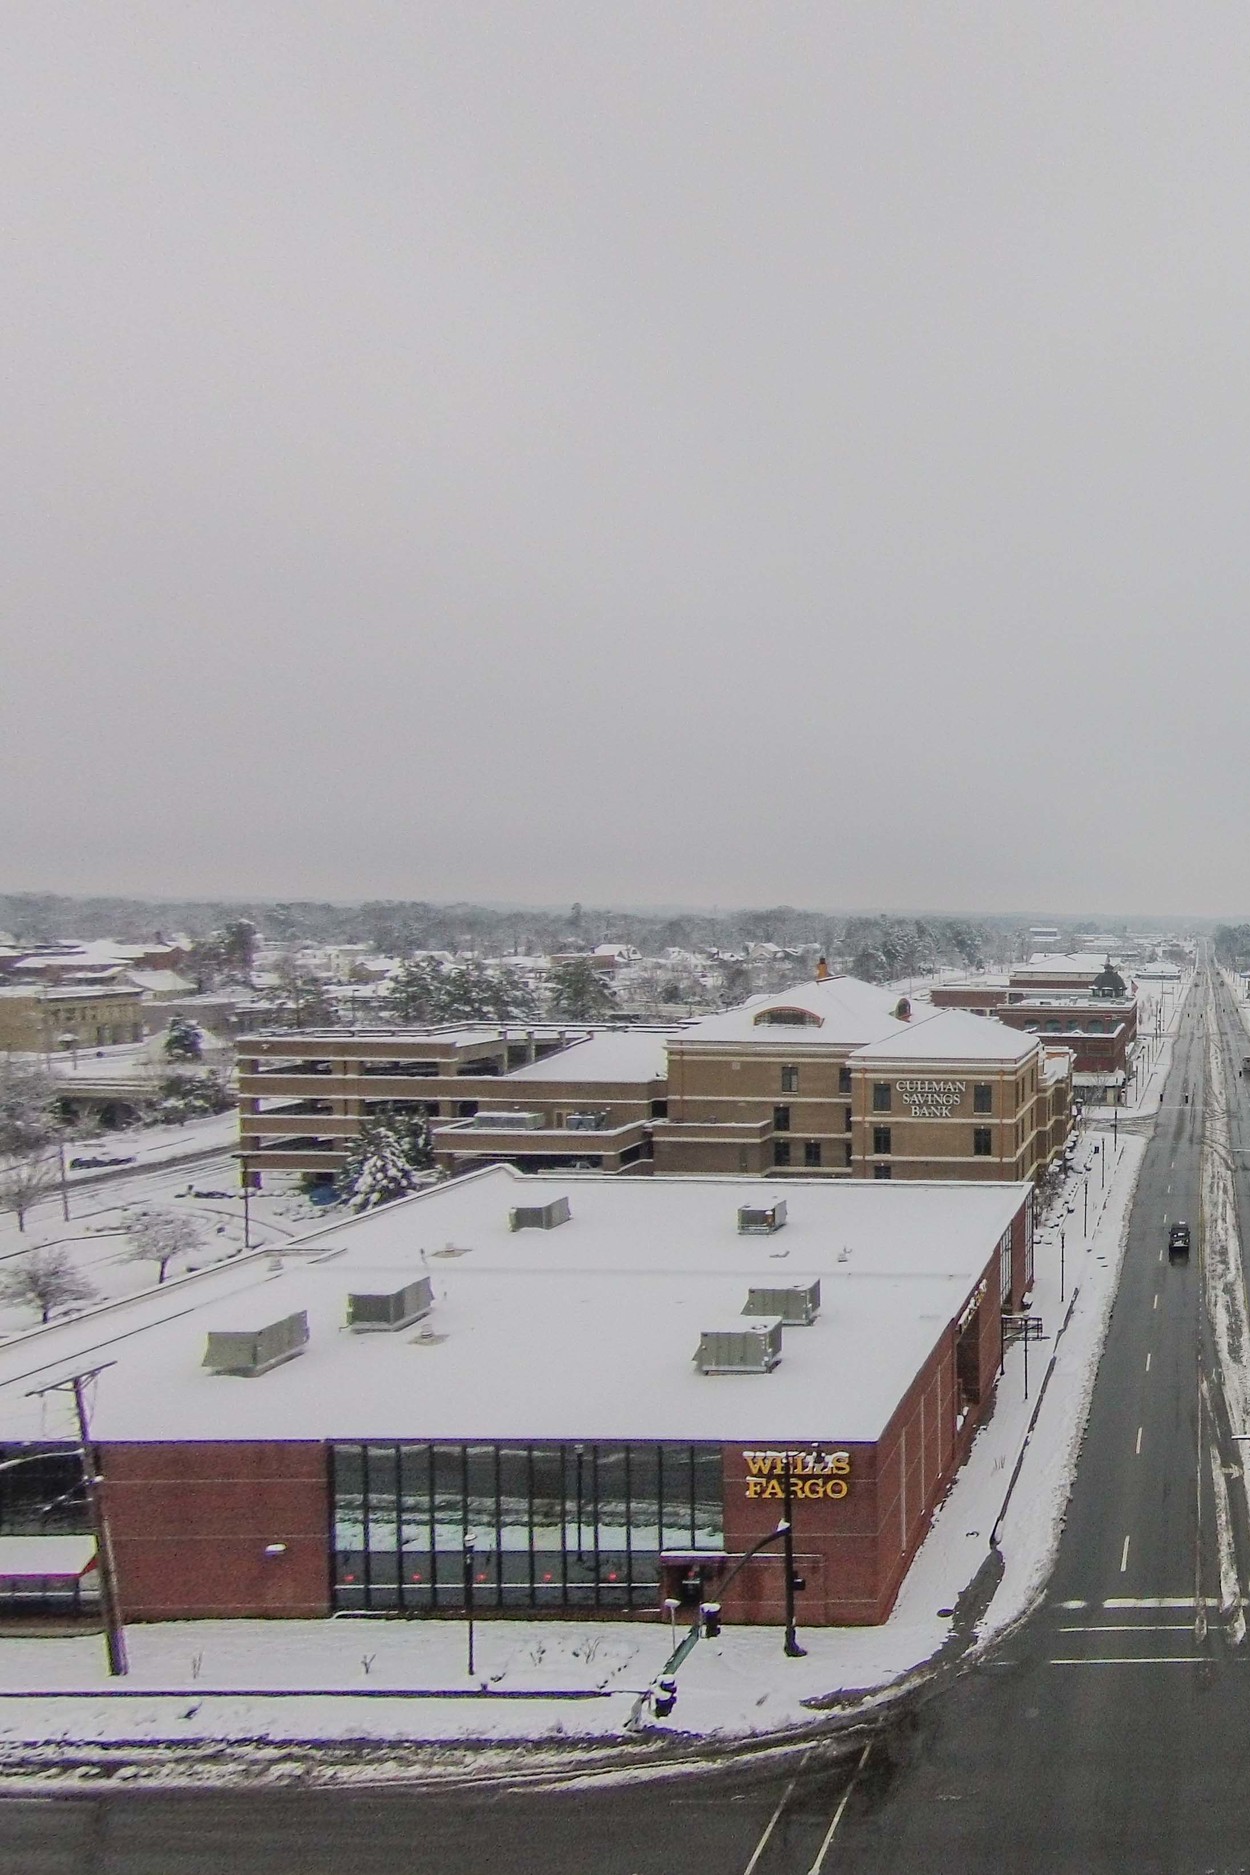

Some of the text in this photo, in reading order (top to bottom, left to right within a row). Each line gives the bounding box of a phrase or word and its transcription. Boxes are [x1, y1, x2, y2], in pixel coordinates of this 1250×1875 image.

[896, 1080, 966, 1092] CULLMAN
[902, 1093, 961, 1105] SAVINGS
[911, 1105, 952, 1117] BANK
[745, 1477, 848, 1499] FARGO
